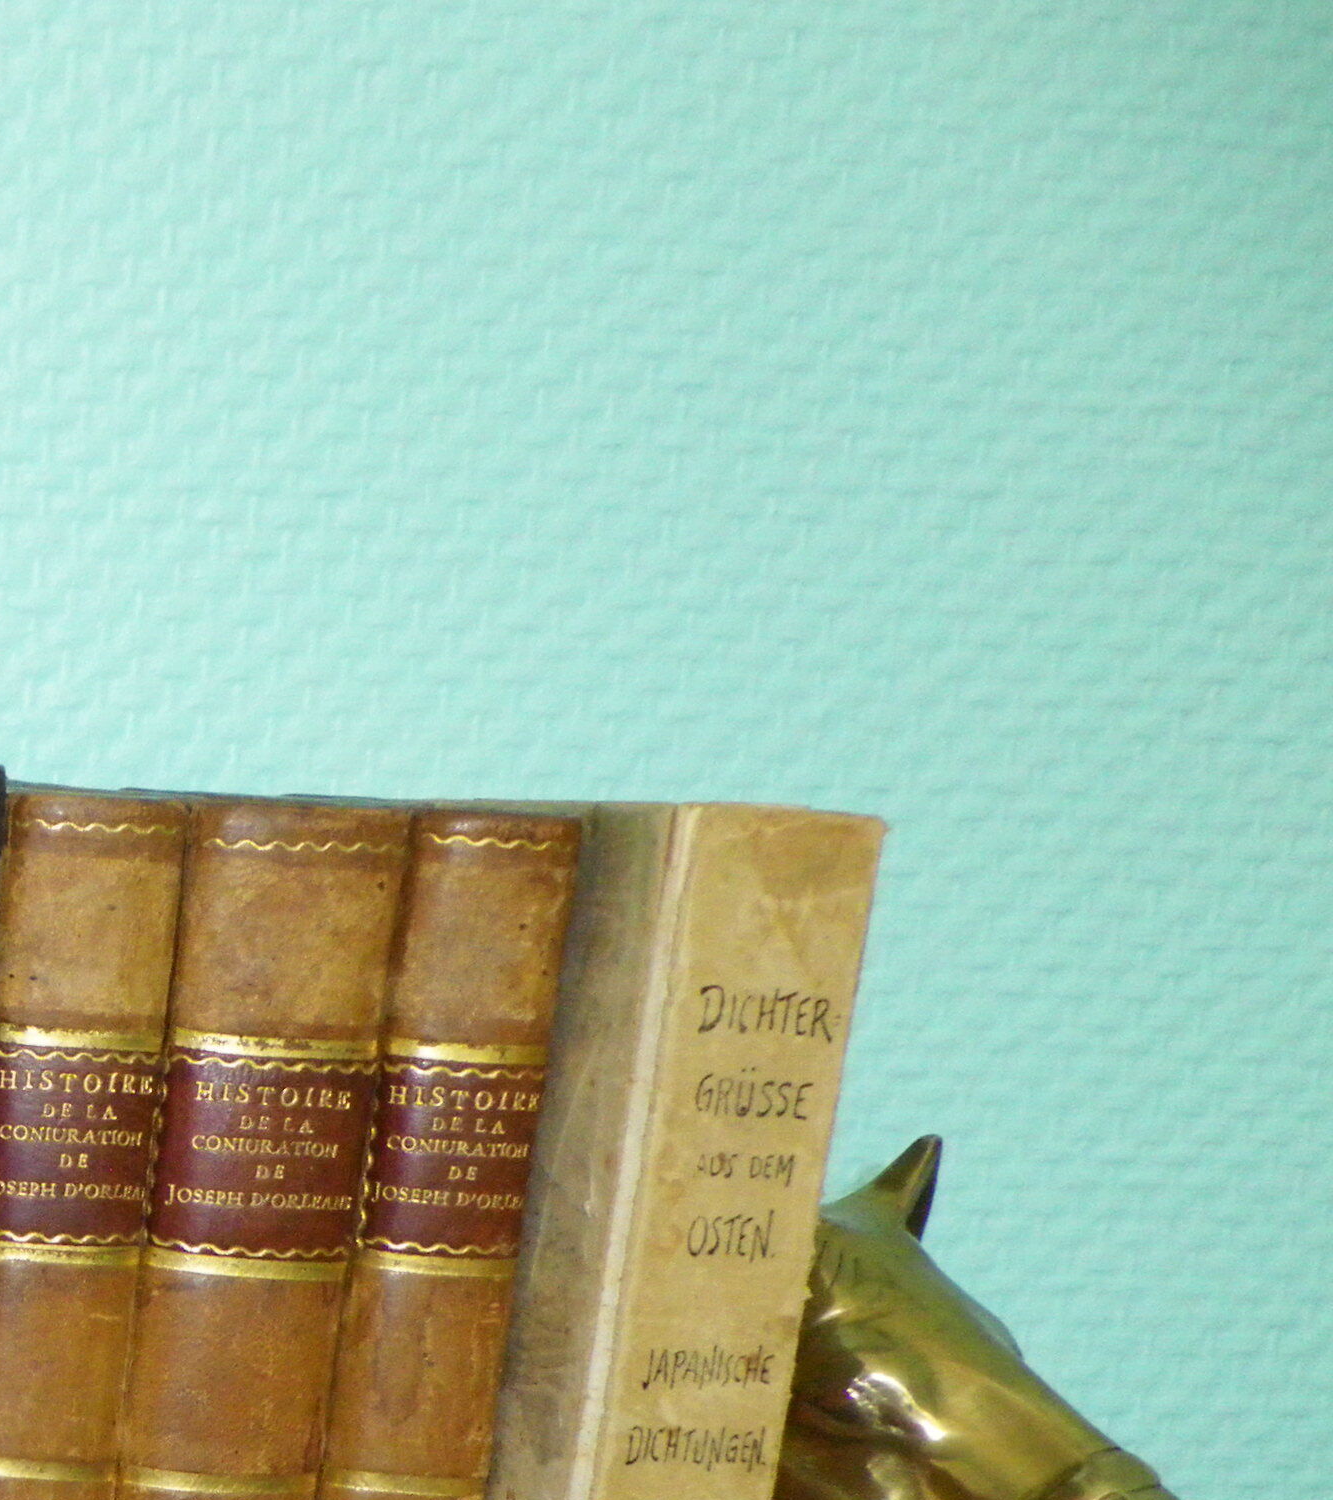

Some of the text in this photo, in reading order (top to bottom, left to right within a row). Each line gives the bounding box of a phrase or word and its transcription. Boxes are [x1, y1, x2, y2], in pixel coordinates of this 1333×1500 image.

[195, 1080, 351, 1110] HISTOIRE
[388, 1084, 540, 1111] HISTOIRE
[695, 1066, 814, 1121] GRÜSSE
[41, 1102, 118, 1120] DE LA
[0, 1124, 142, 1147] CONIURATION
[239, 1115, 314, 1134] DE LA
[432, 1116, 506, 1135] DE LA
[192, 1134, 339, 1159] CONIURATION
[386, 1134, 530, 1158] CONIURATION
[58, 1153, 89, 1169] DE
[255, 1164, 285, 1180] DE
[448, 1165, 478, 1181] DE
[749, 1154, 795, 1187] DEM
[164, 1183, 244, 1207] JOSEPH
[371, 1181, 449, 1207] JOSEPH
[686, 1210, 776, 1265] OSTEN.
[642, 1345, 775, 1390] JAPANISCHE
